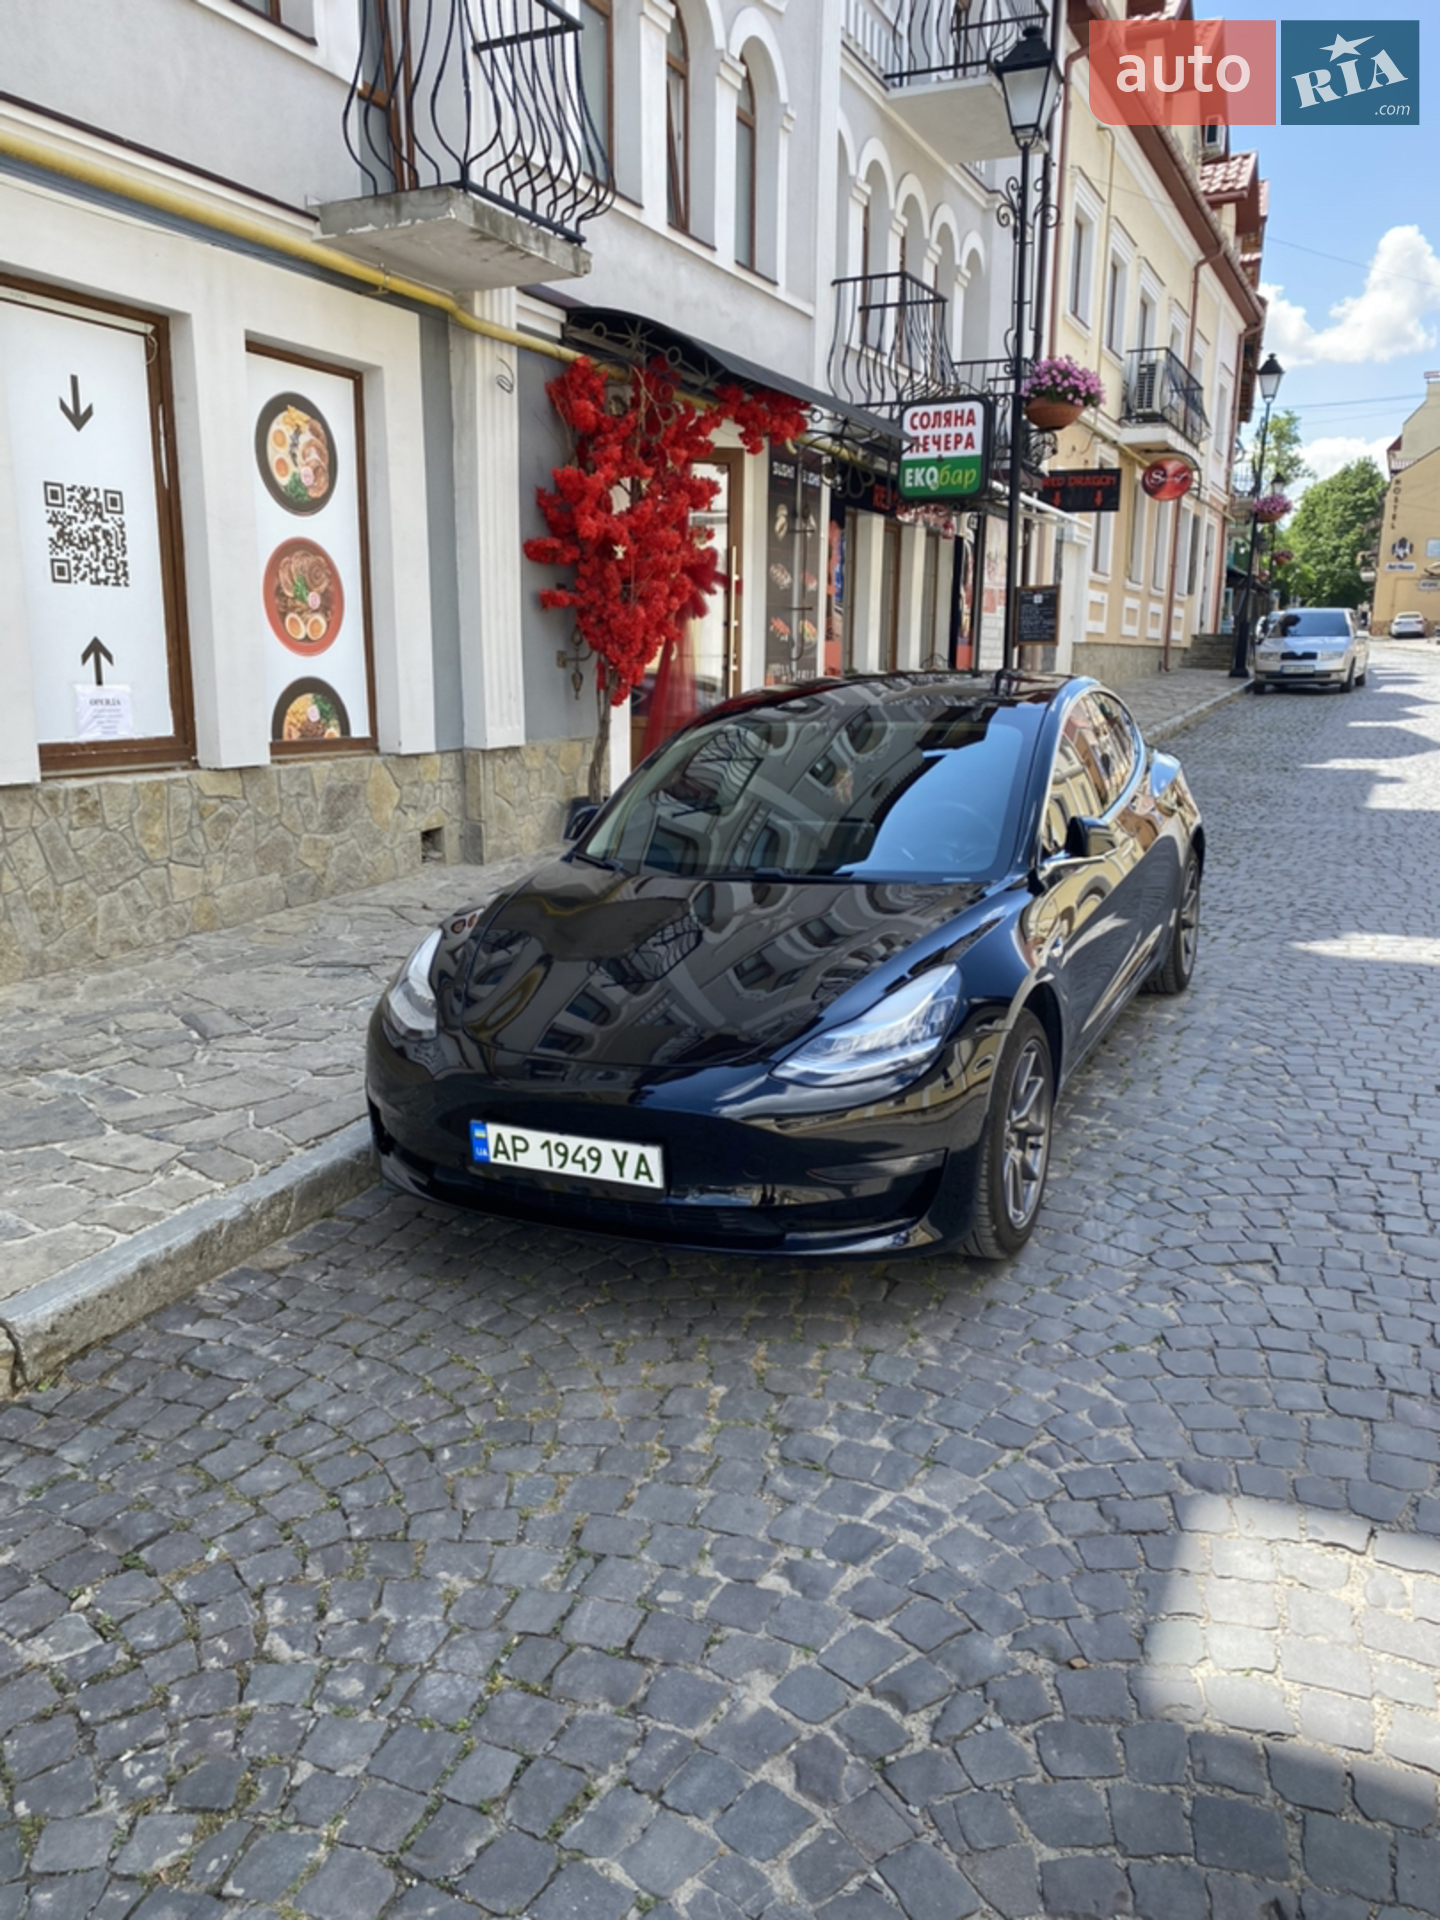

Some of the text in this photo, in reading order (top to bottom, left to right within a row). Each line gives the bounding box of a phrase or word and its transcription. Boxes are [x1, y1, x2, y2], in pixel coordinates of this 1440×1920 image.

[909, 408, 977, 431] СОЛЯНА
[493, 1132, 655, 1183] AP 1949 YA
